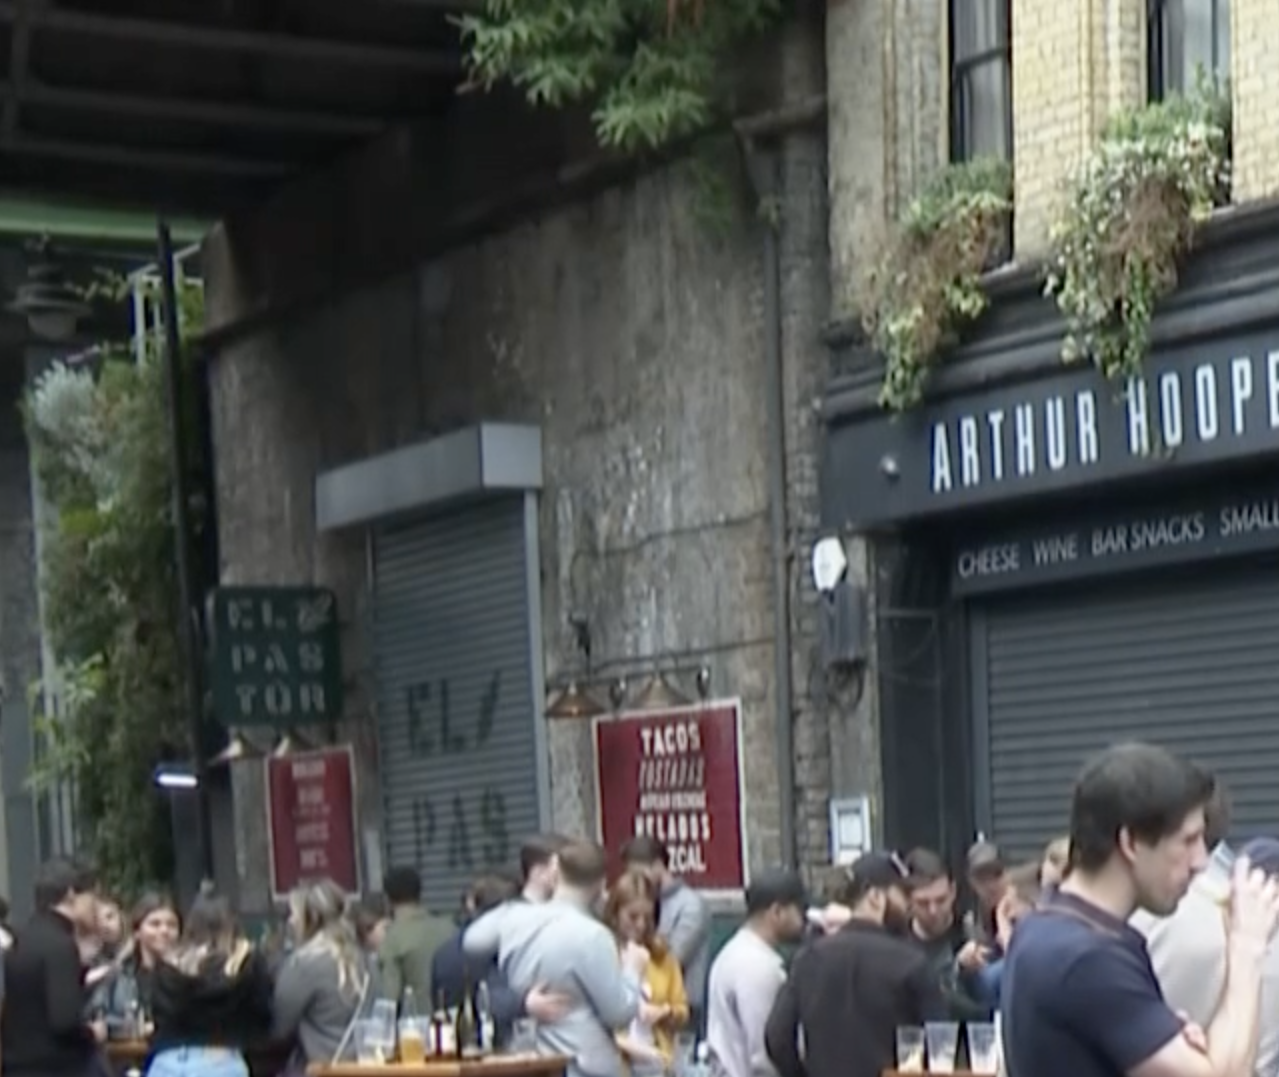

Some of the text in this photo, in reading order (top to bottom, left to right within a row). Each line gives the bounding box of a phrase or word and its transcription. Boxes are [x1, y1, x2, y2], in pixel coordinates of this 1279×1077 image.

[931, 391, 1099, 494] ARTHUR
[957, 543, 1020, 579] CHEESE
[1032, 532, 1079, 567] WINE
[1091, 527, 1128, 557] BAR
[1130, 511, 1205, 549] SNACKS
[230, 642, 325, 673] PAS
[235, 681, 325, 715] TOR
[641, 723, 701, 756] TACOS
[666, 845, 707, 872] ZCAL
